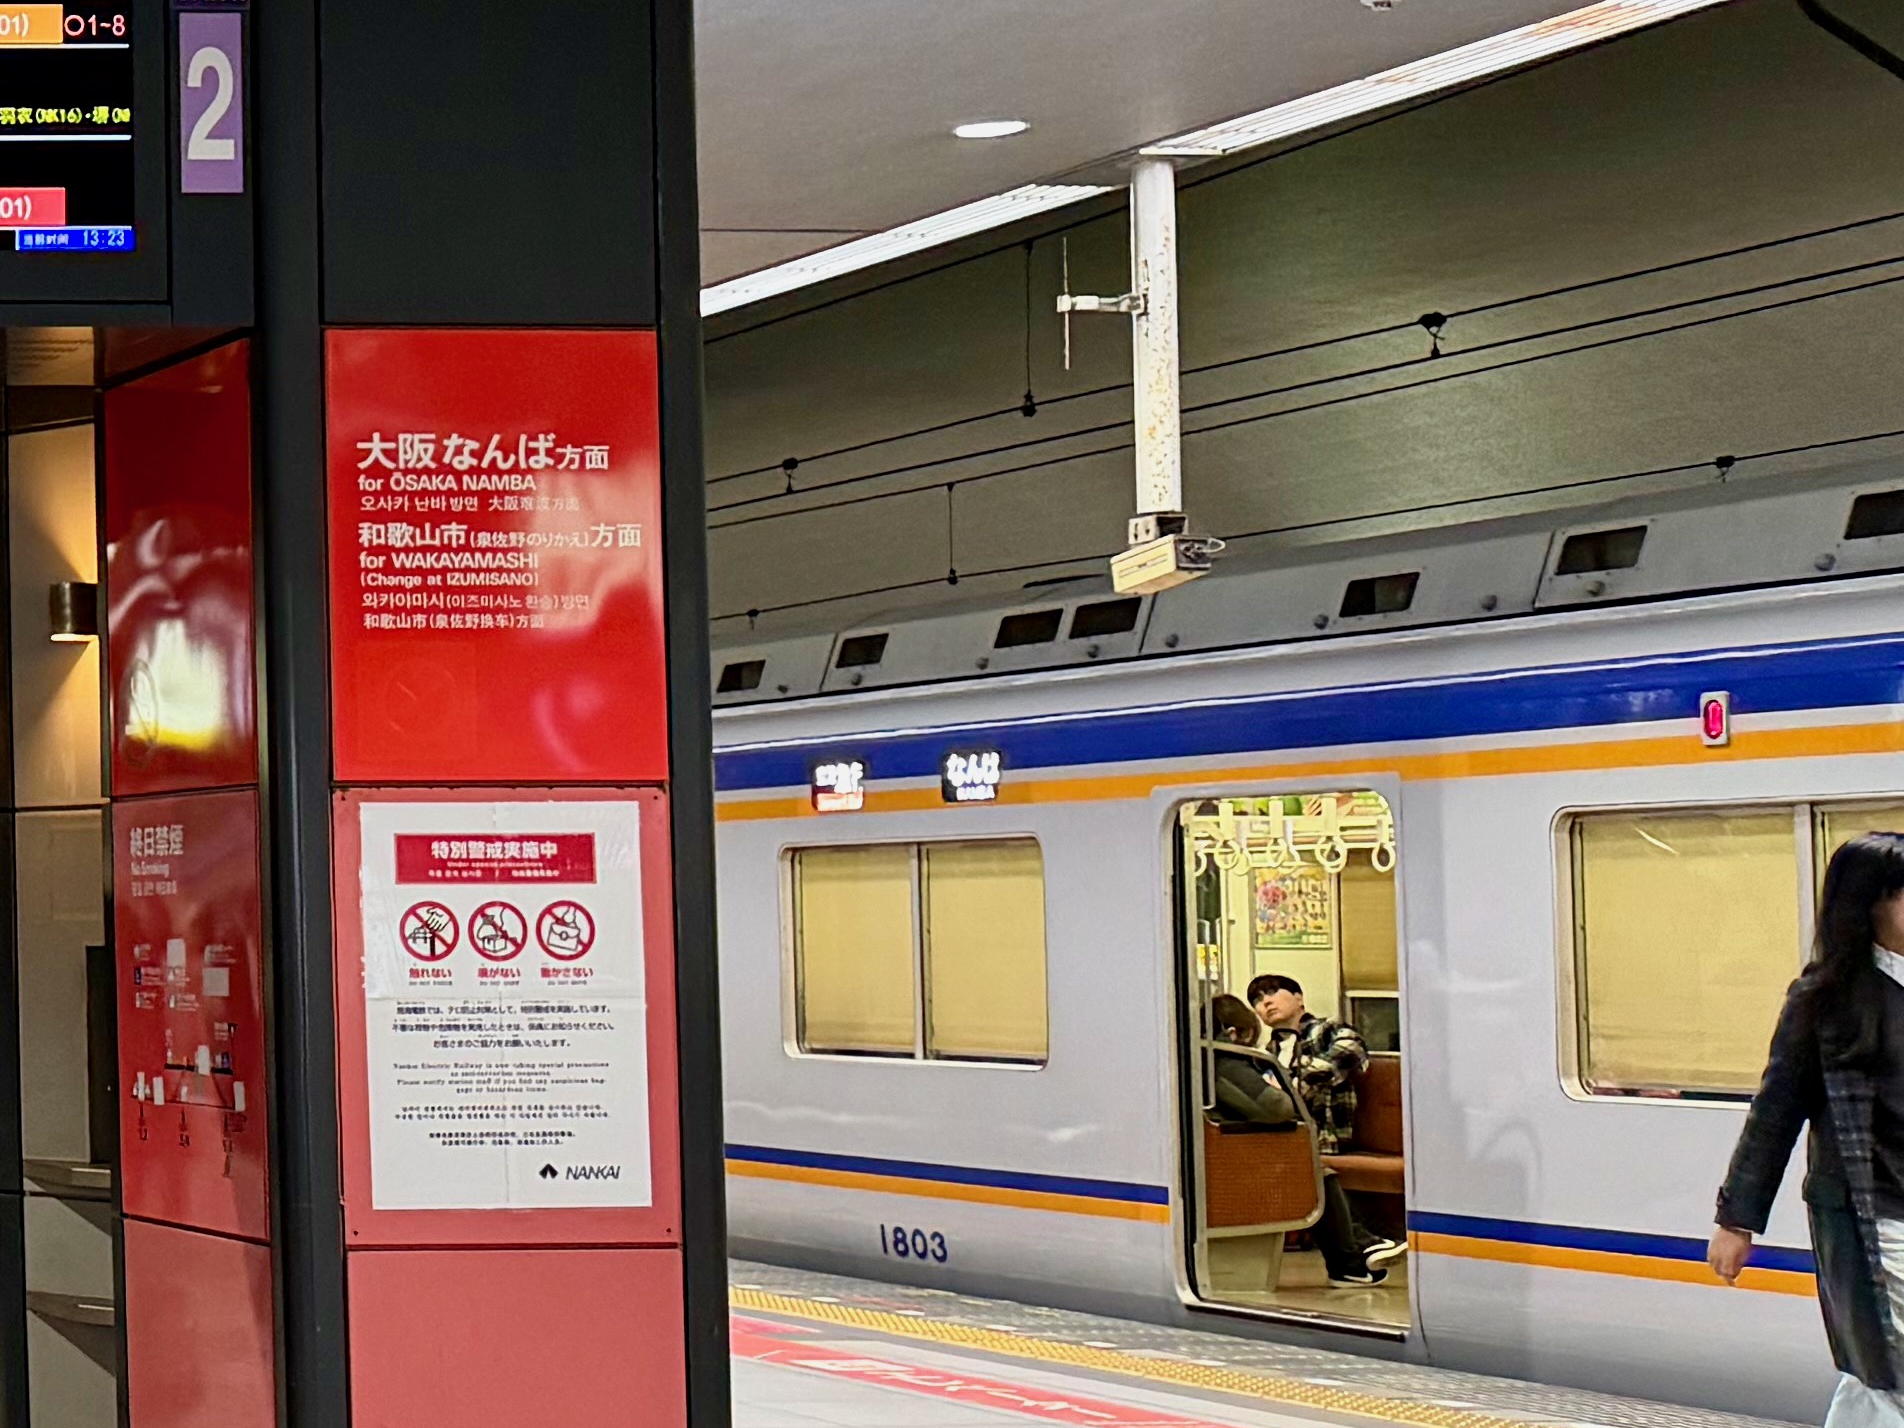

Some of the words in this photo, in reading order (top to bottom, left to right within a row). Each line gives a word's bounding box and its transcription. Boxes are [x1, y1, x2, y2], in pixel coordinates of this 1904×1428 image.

[187, 46, 235, 160] 2
[83, 230, 125, 246] 13:23
[358, 474, 383, 491] for
[463, 474, 537, 491] NAMBA
[360, 496, 409, 512] 오사카
[415, 496, 446, 512] 난바
[450, 496, 478, 512] 방면
[359, 552, 386, 569] for
[391, 552, 539, 569] WAKAYAMASHI
[361, 572, 422, 588] (Change
[427, 574, 441, 587] at
[446, 573, 539, 588] IZUMISANO)
[130, 824, 184, 858] 終日禁煙
[431, 840, 557, 859] 特別警戒実施中
[566, 1165, 621, 1180] NANKAI
[880, 1223, 948, 1263] 1803
